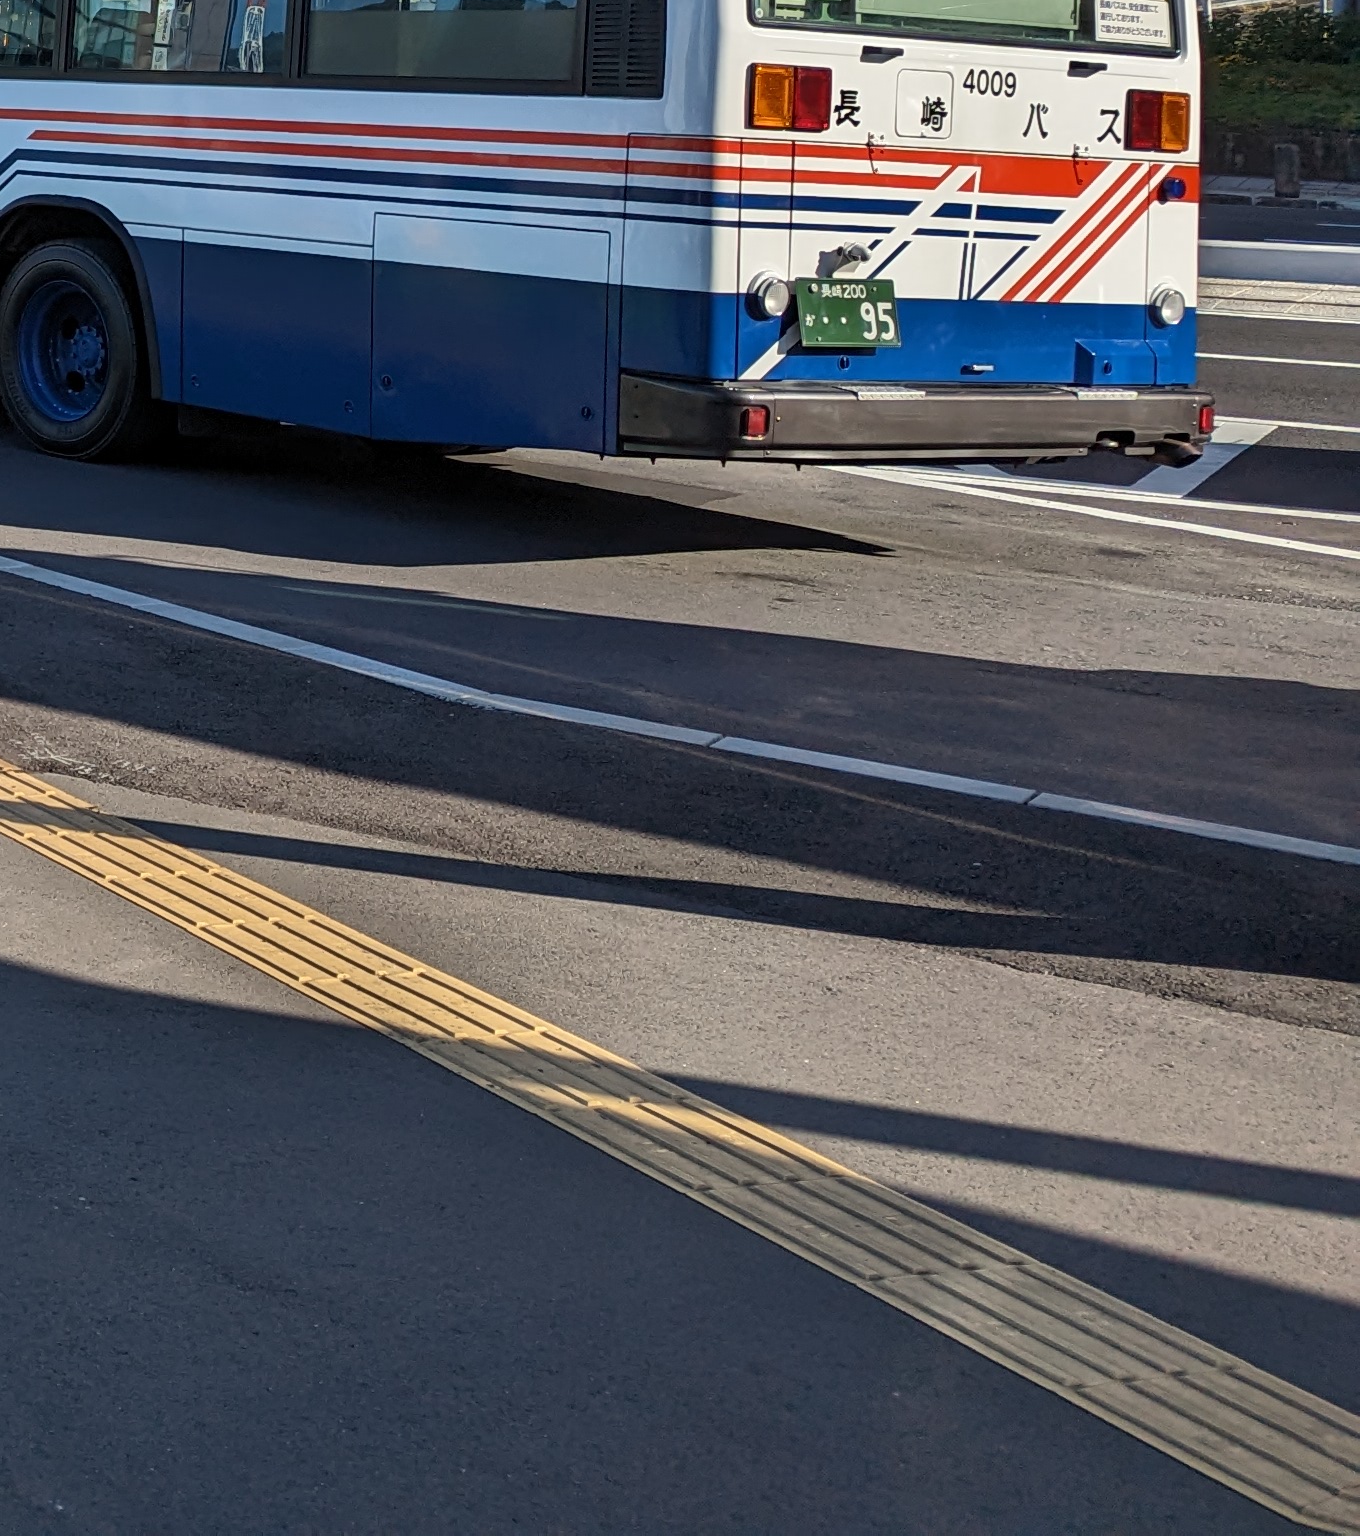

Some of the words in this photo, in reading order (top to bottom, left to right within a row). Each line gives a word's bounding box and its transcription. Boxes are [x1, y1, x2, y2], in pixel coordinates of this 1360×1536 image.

[963, 68, 1018, 98] 4009
[834, 90, 1123, 145] 長崎バス
[821, 284, 867, 299] 長崎200
[860, 301, 896, 341] 95
